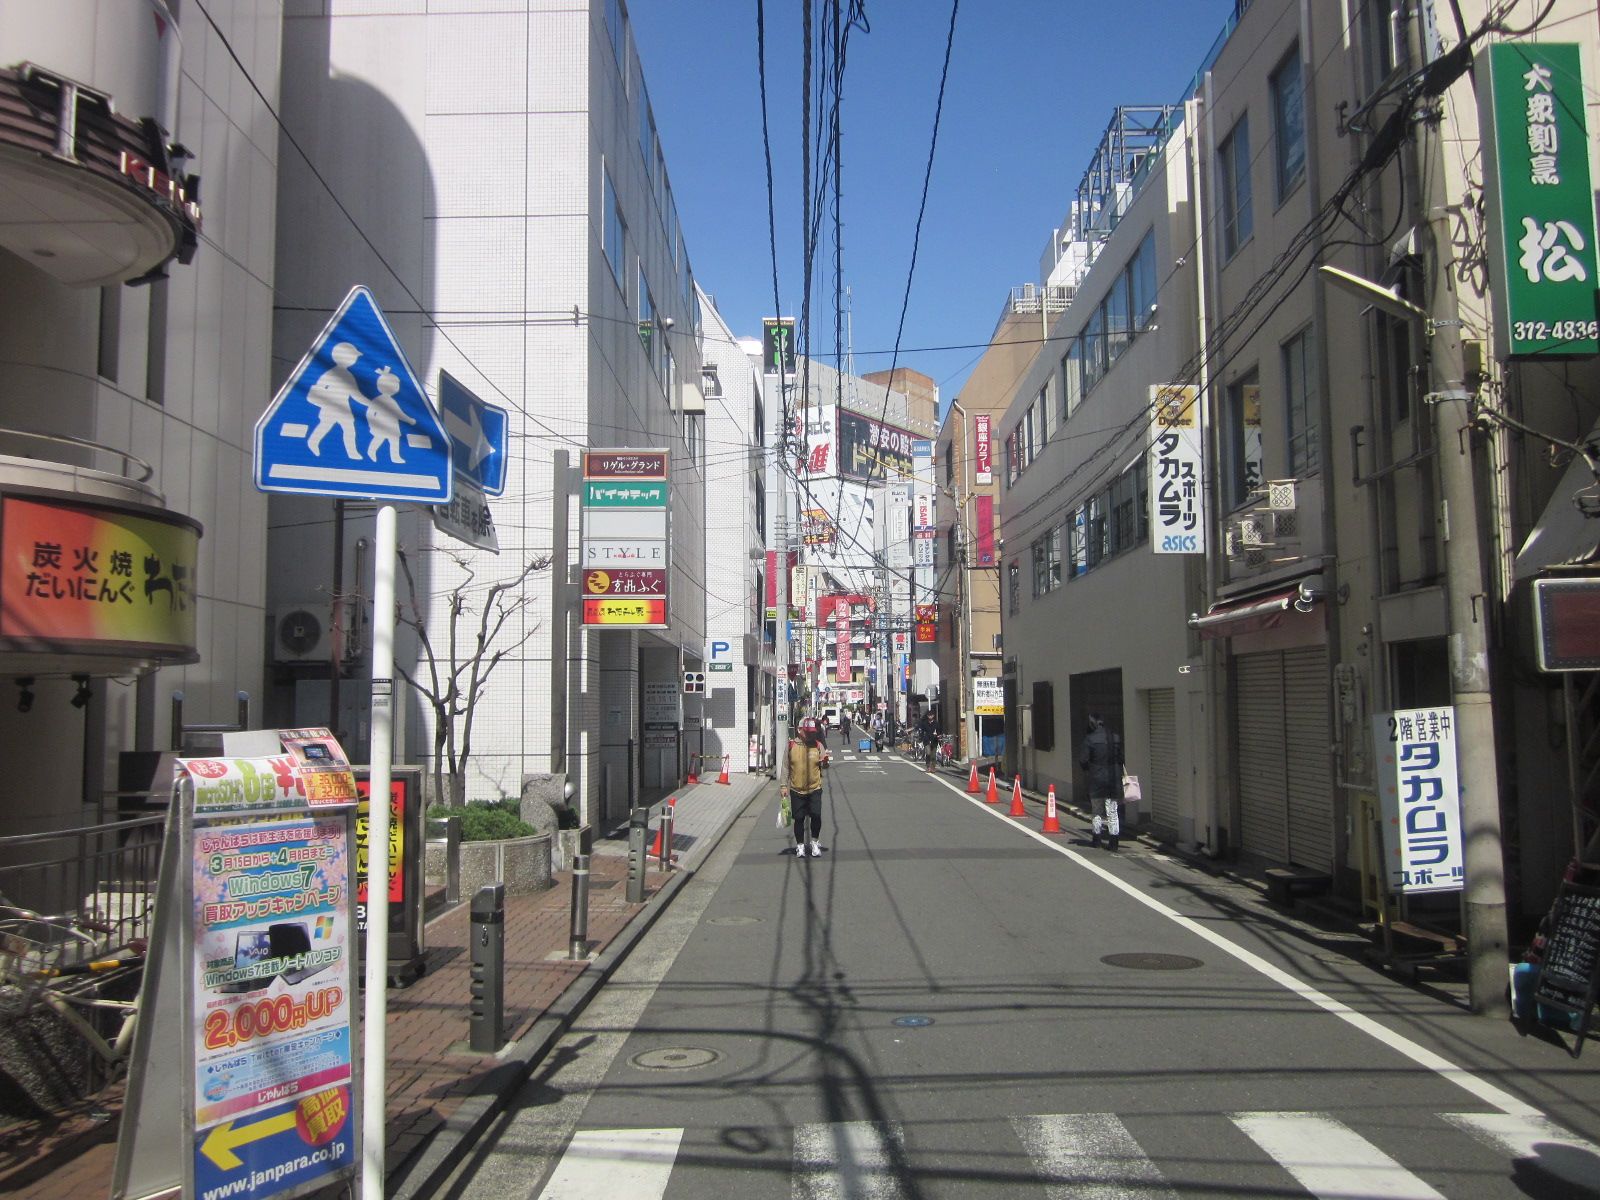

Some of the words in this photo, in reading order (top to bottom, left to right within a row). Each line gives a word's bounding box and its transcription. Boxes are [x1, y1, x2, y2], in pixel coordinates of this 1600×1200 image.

[1518, 217, 1586, 284] 松
[977, 422, 989, 471] 銀座カラー
[603, 460, 661, 471] リゲル・グランド
[1158, 433, 1182, 527] タカムラ
[590, 486, 660, 500] バイオテック
[1181, 462, 1197, 530] スポーツ
[588, 547, 661, 559] STYLE
[1162, 535, 1196, 551] asics
[32, 542, 134, 578] 炭火焼
[26, 573, 136, 604] だいにんぐ
[711, 641, 730, 660] P
[1388, 711, 1450, 742] 2階営業中
[203, 1141, 345, 1200] www.janpara.co.jp
